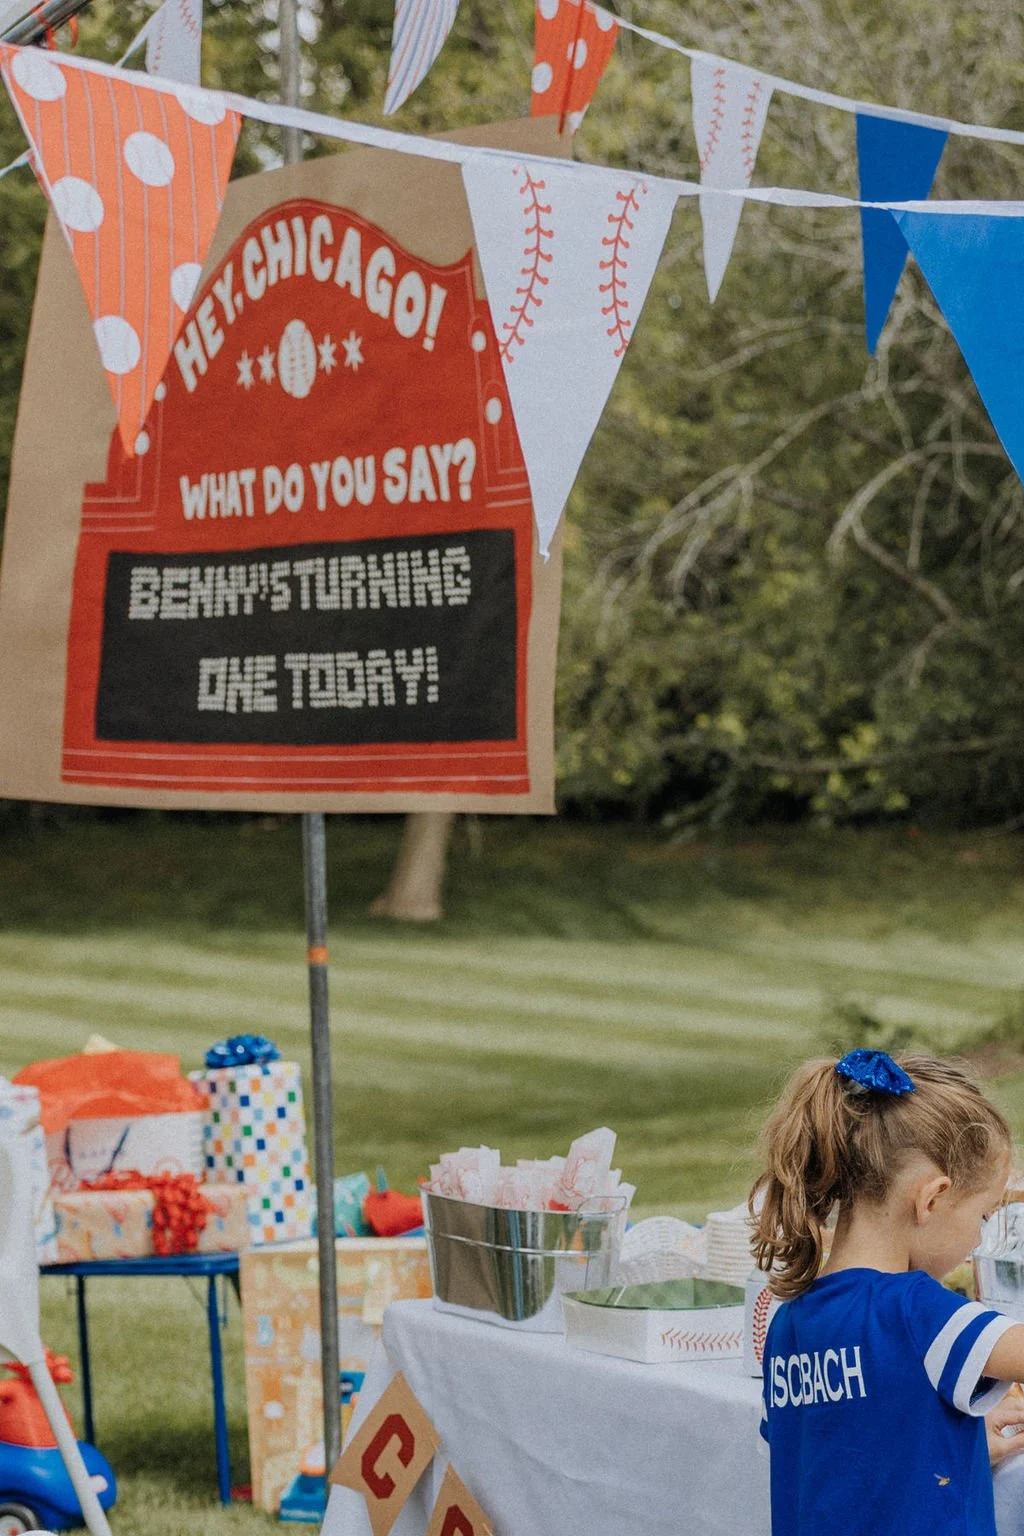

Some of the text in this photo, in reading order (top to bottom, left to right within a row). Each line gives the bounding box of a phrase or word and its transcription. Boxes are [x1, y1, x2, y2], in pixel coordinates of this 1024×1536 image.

[173, 215, 448, 393] HEY, CHICAGO!
[179, 438, 476, 520] WHAT DO YOU SAY?
[198, 646, 439, 713] ONE TODAY!
